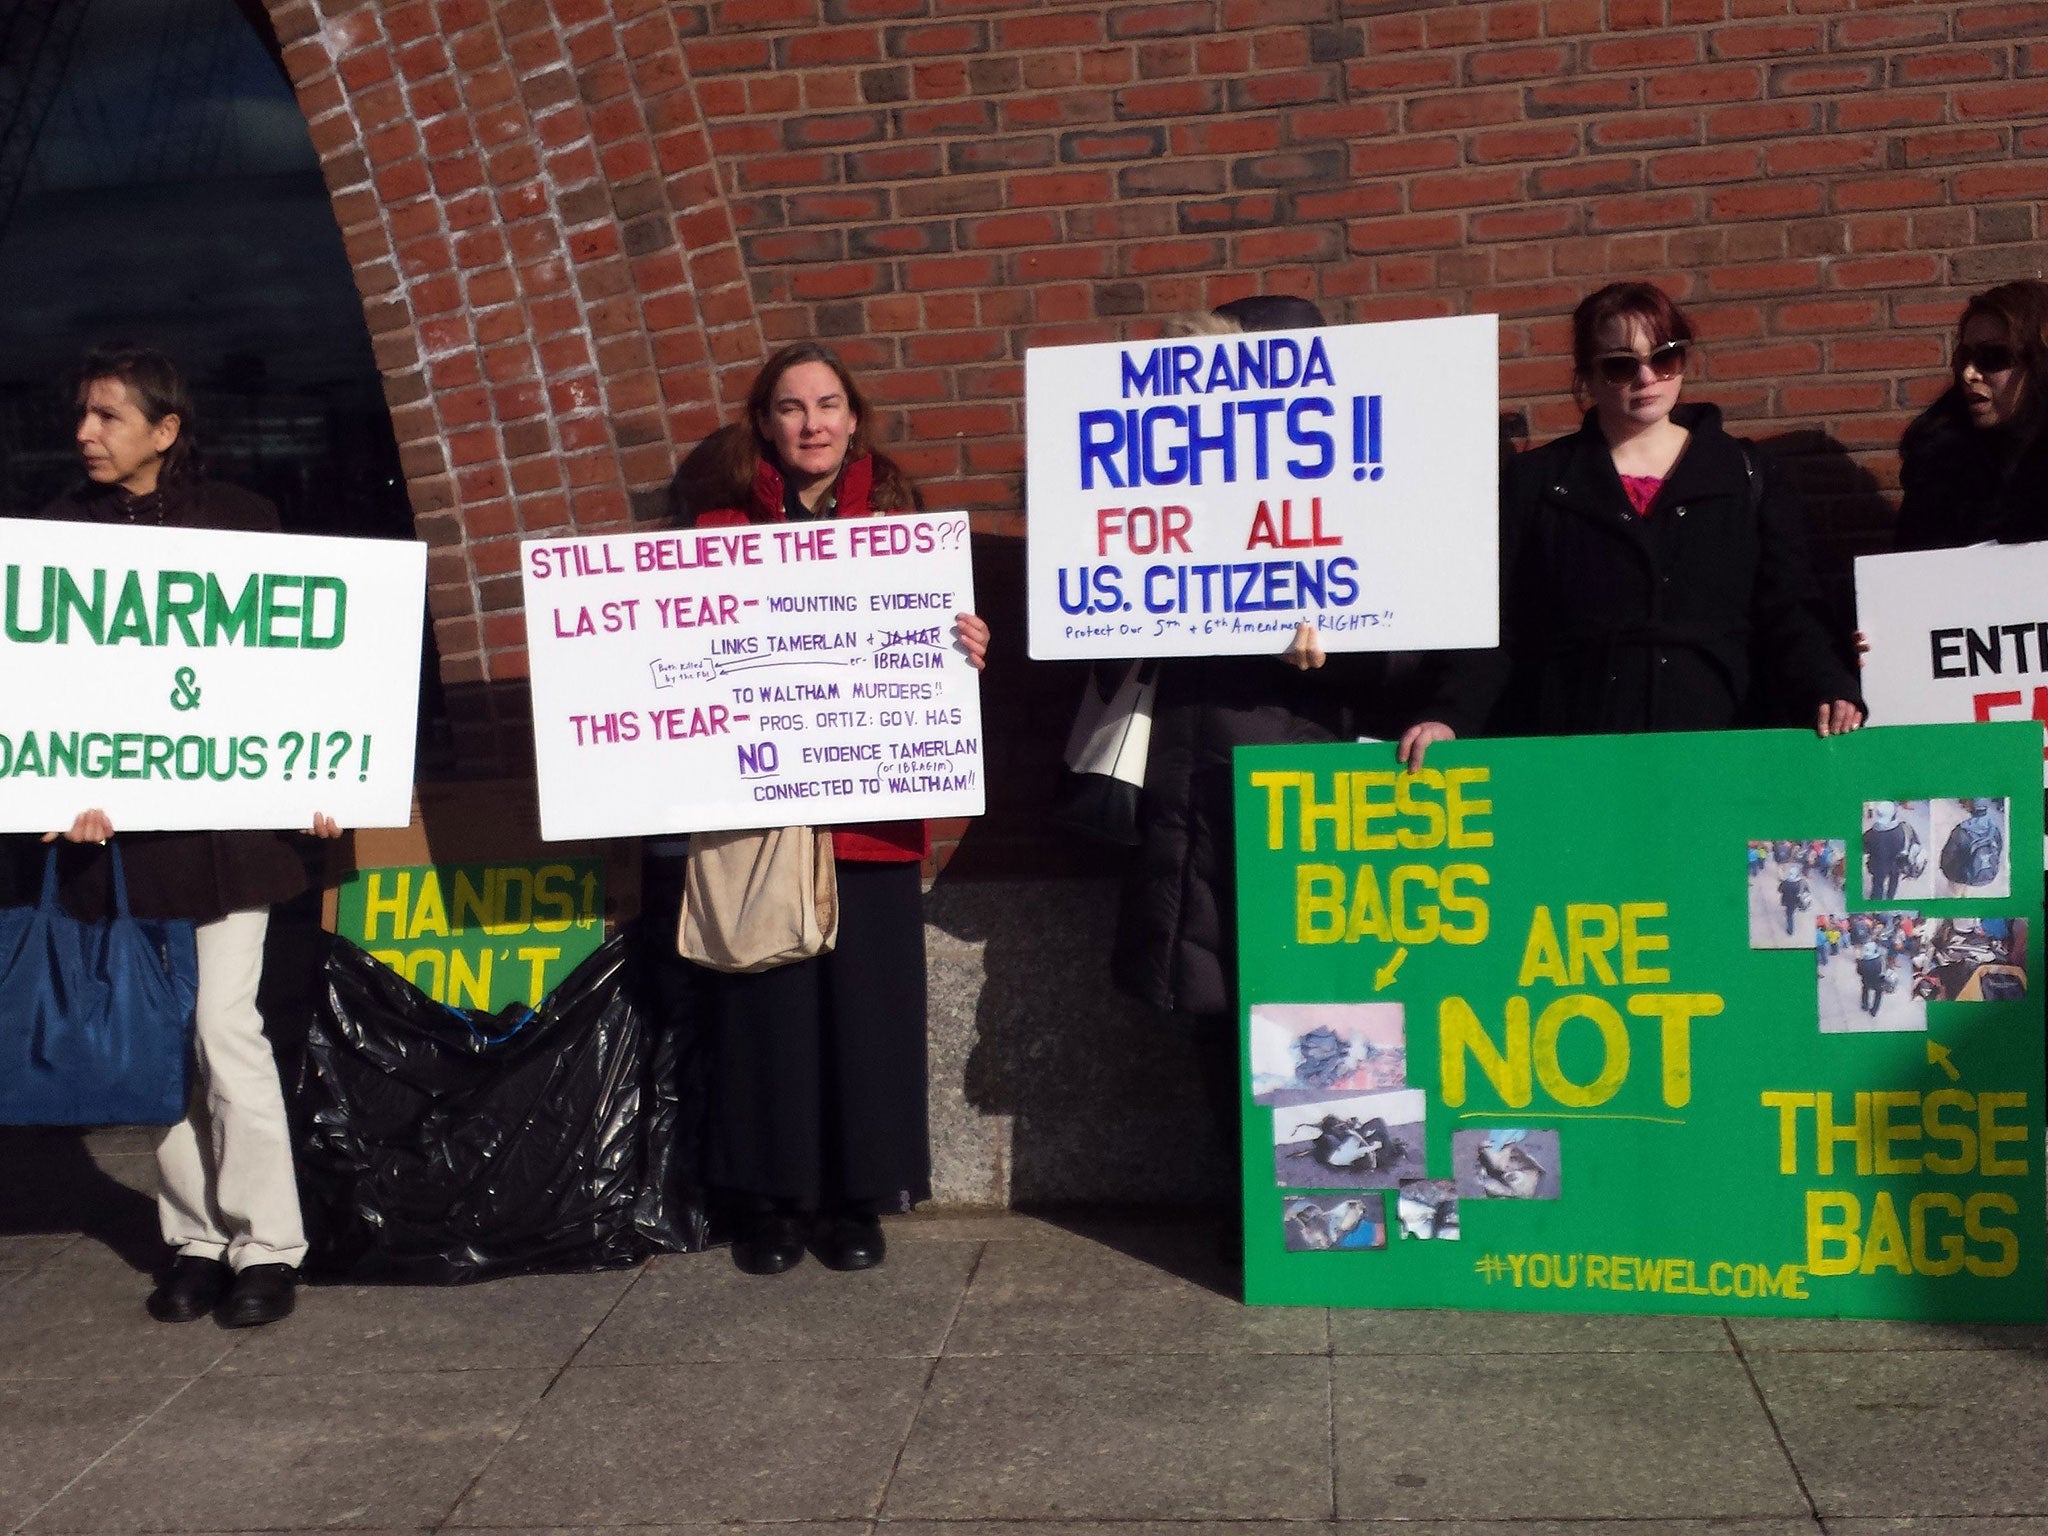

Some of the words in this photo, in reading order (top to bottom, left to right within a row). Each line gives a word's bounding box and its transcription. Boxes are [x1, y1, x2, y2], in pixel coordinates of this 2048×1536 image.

[1120, 335, 1336, 400] MIRANDA
[532, 543, 625, 579] STILL
[634, 533, 763, 573] BELIEVE
[773, 528, 837, 563] THE
[849, 520, 967, 558] FEDS??
[1097, 505, 1193, 556] FOR
[1246, 497, 1343, 550] ALL
[5, 564, 347, 649] UNARMED
[1058, 565, 1132, 615] U.S.
[1143, 556, 1361, 615] CITIZENS
[554, 600, 640, 638] LAST
[655, 595, 759, 628] YEAR-
[711, 636, 759, 656] LINKS
[769, 632, 857, 654] TAMERLAN
[1065, 624, 1113, 639] Protect
[1119, 624, 1143, 635] Our
[1204, 617, 1228, 634] 6th
[1317, 610, 1394, 631] RIGHTS!!
[170, 666, 201, 711] &
[874, 651, 944, 669] IBRAGIM
[733, 688, 753, 703] TO
[759, 683, 840, 702] WALTHAM
[853, 681, 943, 699] MURDERS!!
[569, 712, 640, 746] THIS
[648, 705, 750, 740] YEAR-
[760, 715, 809, 731] PROS.
[816, 712, 873, 727] ORTIZ:
[880, 711, 919, 726] GOV.
[926, 708, 961, 725] HAS
[737, 741, 780, 775] NO
[802, 744, 882, 764] EVIDENCE
[889, 738, 977, 760] TAMERLAN
[753, 778, 854, 802] CONNECTED
[859, 778, 880, 795] TO
[887, 770, 976, 794] WALTHAM!!
[1251, 767, 1493, 851] THESE
[364, 865, 576, 941] HANDS
[1297, 864, 1489, 945] BAGS
[1519, 902, 1669, 986] ARE
[368, 946, 561, 1013] ON'T
[1440, 993, 1724, 1108] NOT
[1761, 1088, 2029, 1176] THESE
[1804, 1191, 2020, 1278] BAGS
